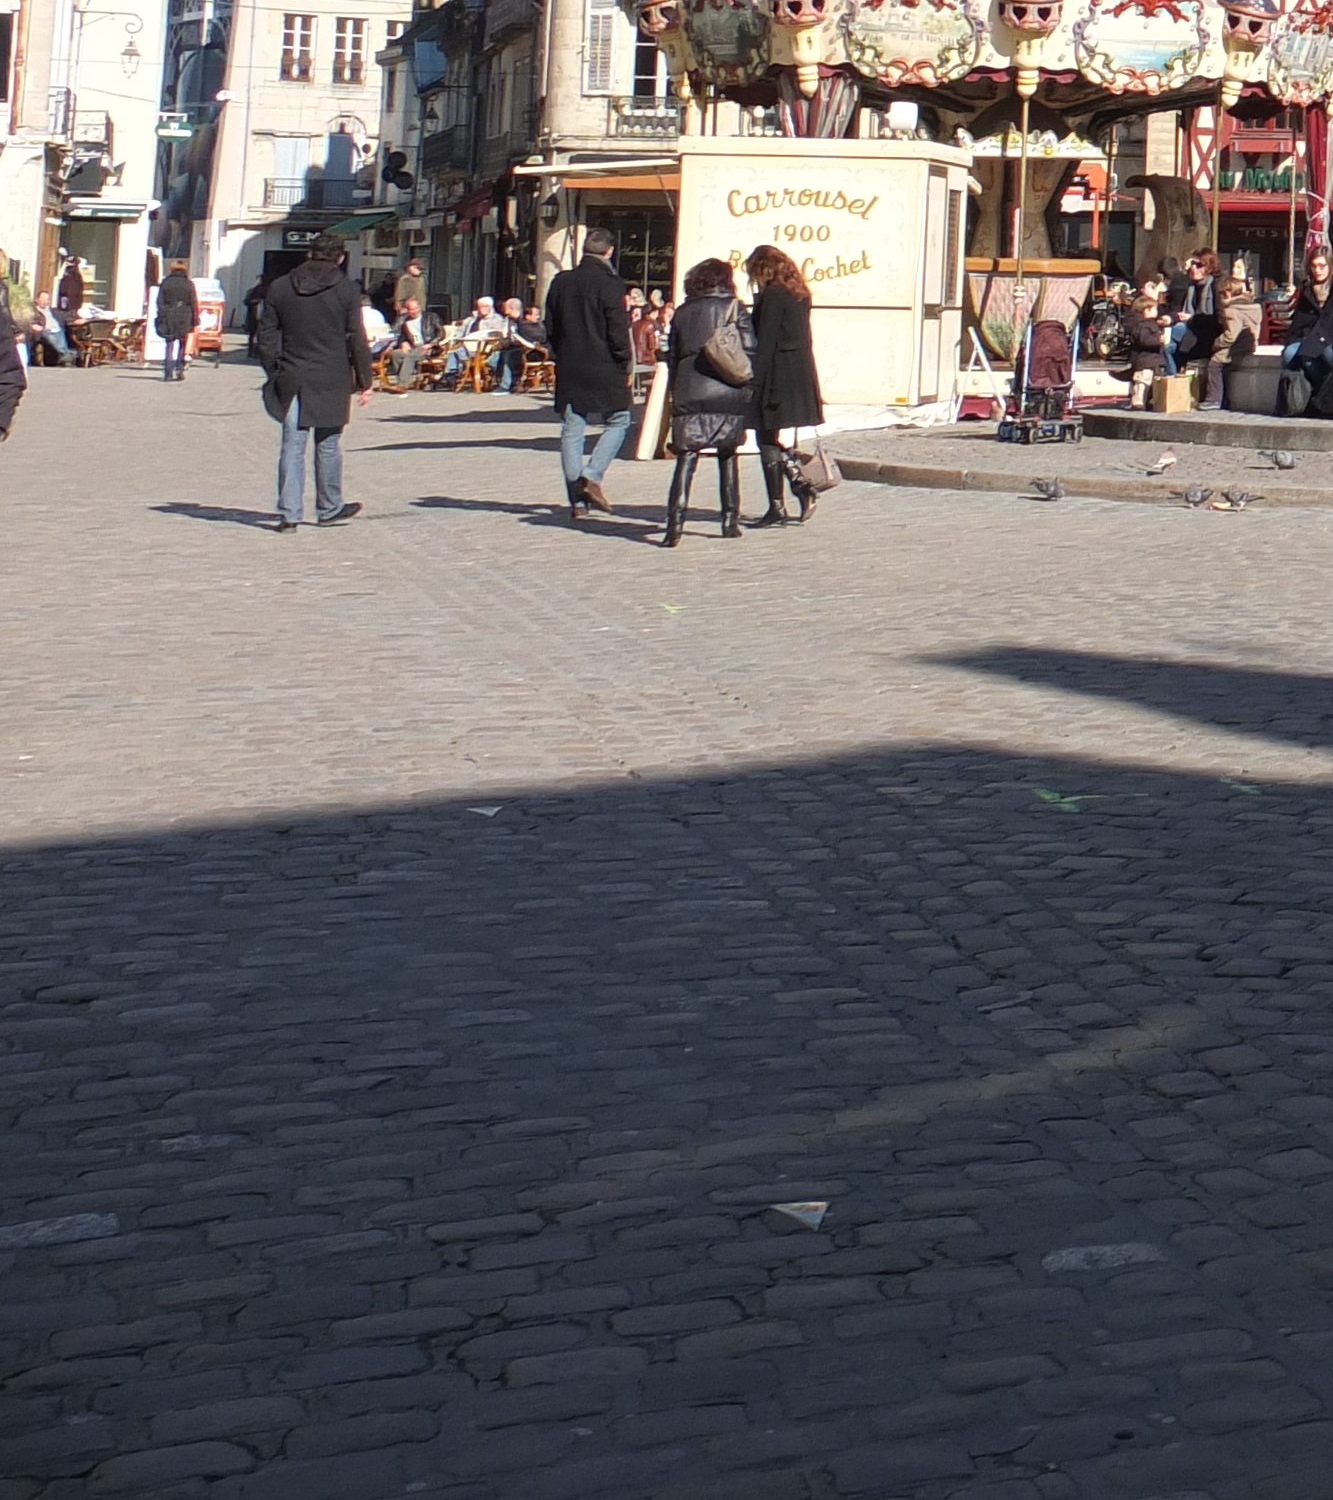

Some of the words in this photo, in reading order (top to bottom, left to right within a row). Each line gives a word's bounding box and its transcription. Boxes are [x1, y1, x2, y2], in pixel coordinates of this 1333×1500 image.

[727, 188, 879, 220] Carrousel
[773, 224, 831, 242] 1900
[802, 250, 873, 283] Cochet
